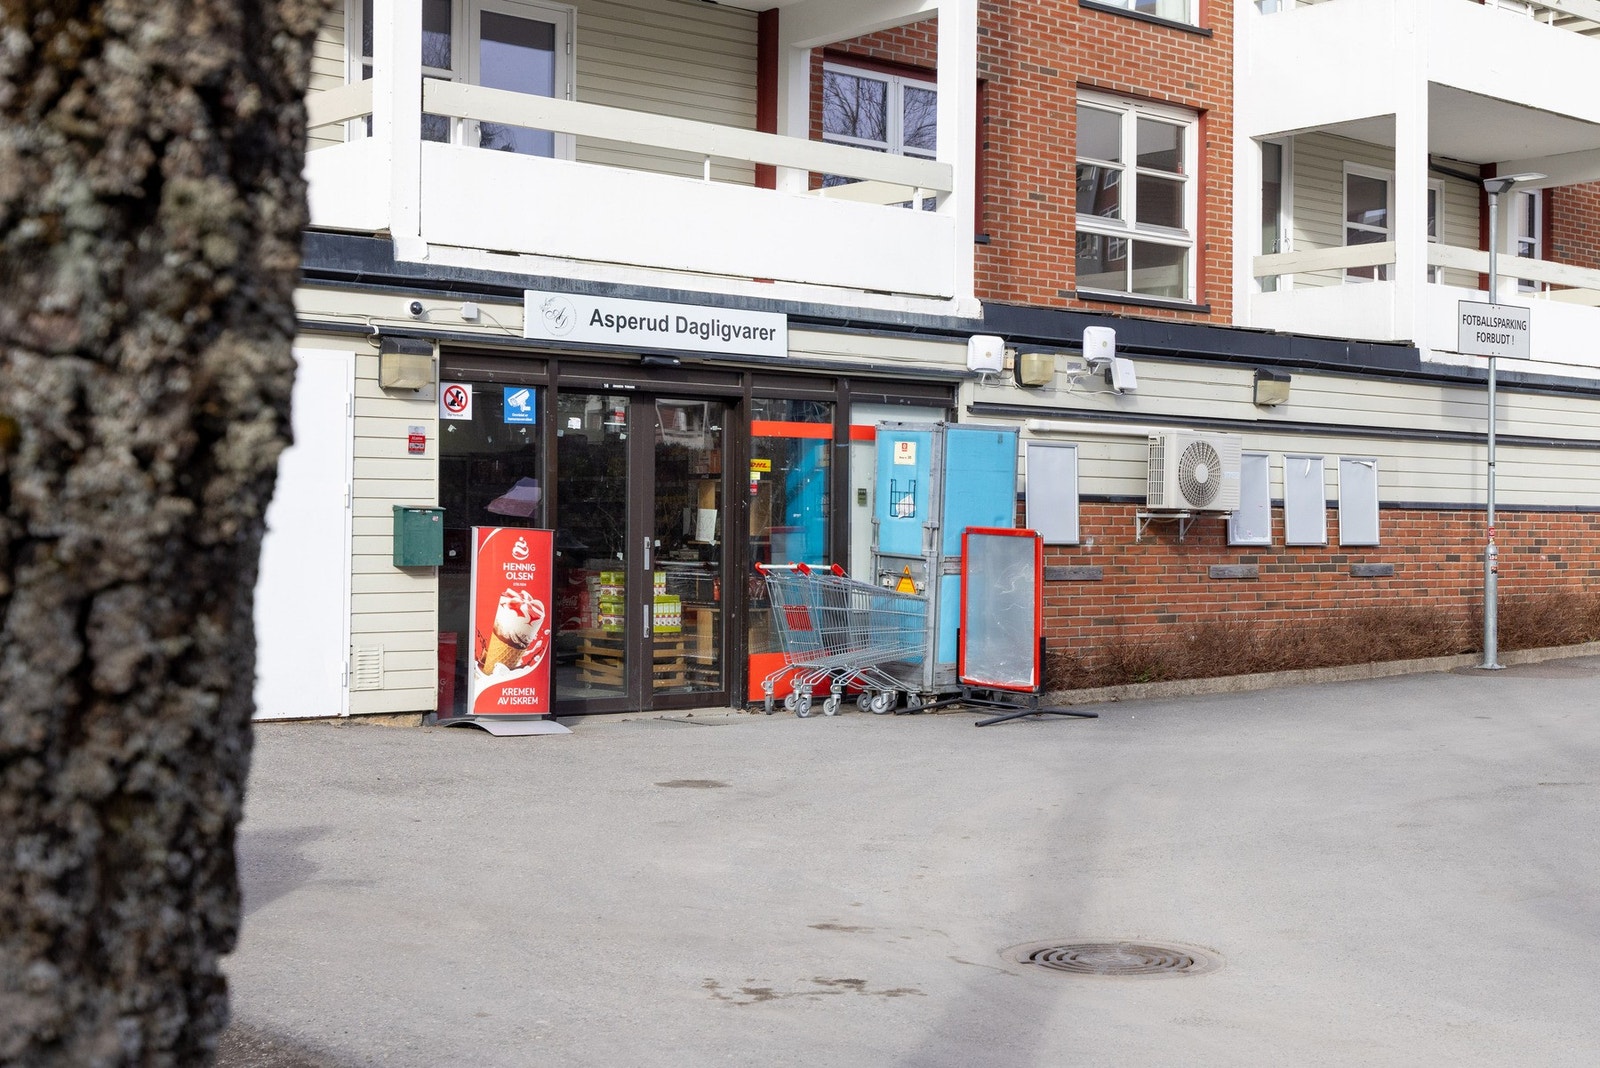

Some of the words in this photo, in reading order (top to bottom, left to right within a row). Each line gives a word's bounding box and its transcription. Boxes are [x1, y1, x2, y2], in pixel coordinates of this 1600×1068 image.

[589, 308, 669, 332] Asperud
[675, 315, 776, 341] Dagligvarer
[1462, 314, 1527, 331] FOTBALLSPARKING
[1476, 331, 1510, 345] FORBUDT
[503, 562, 536, 572] HENNIG
[505, 571, 534, 580] OLSEN
[502, 687, 536, 696] KREMEN
[497, 696, 509, 705] AV
[510, 697, 539, 705] ISKREM
